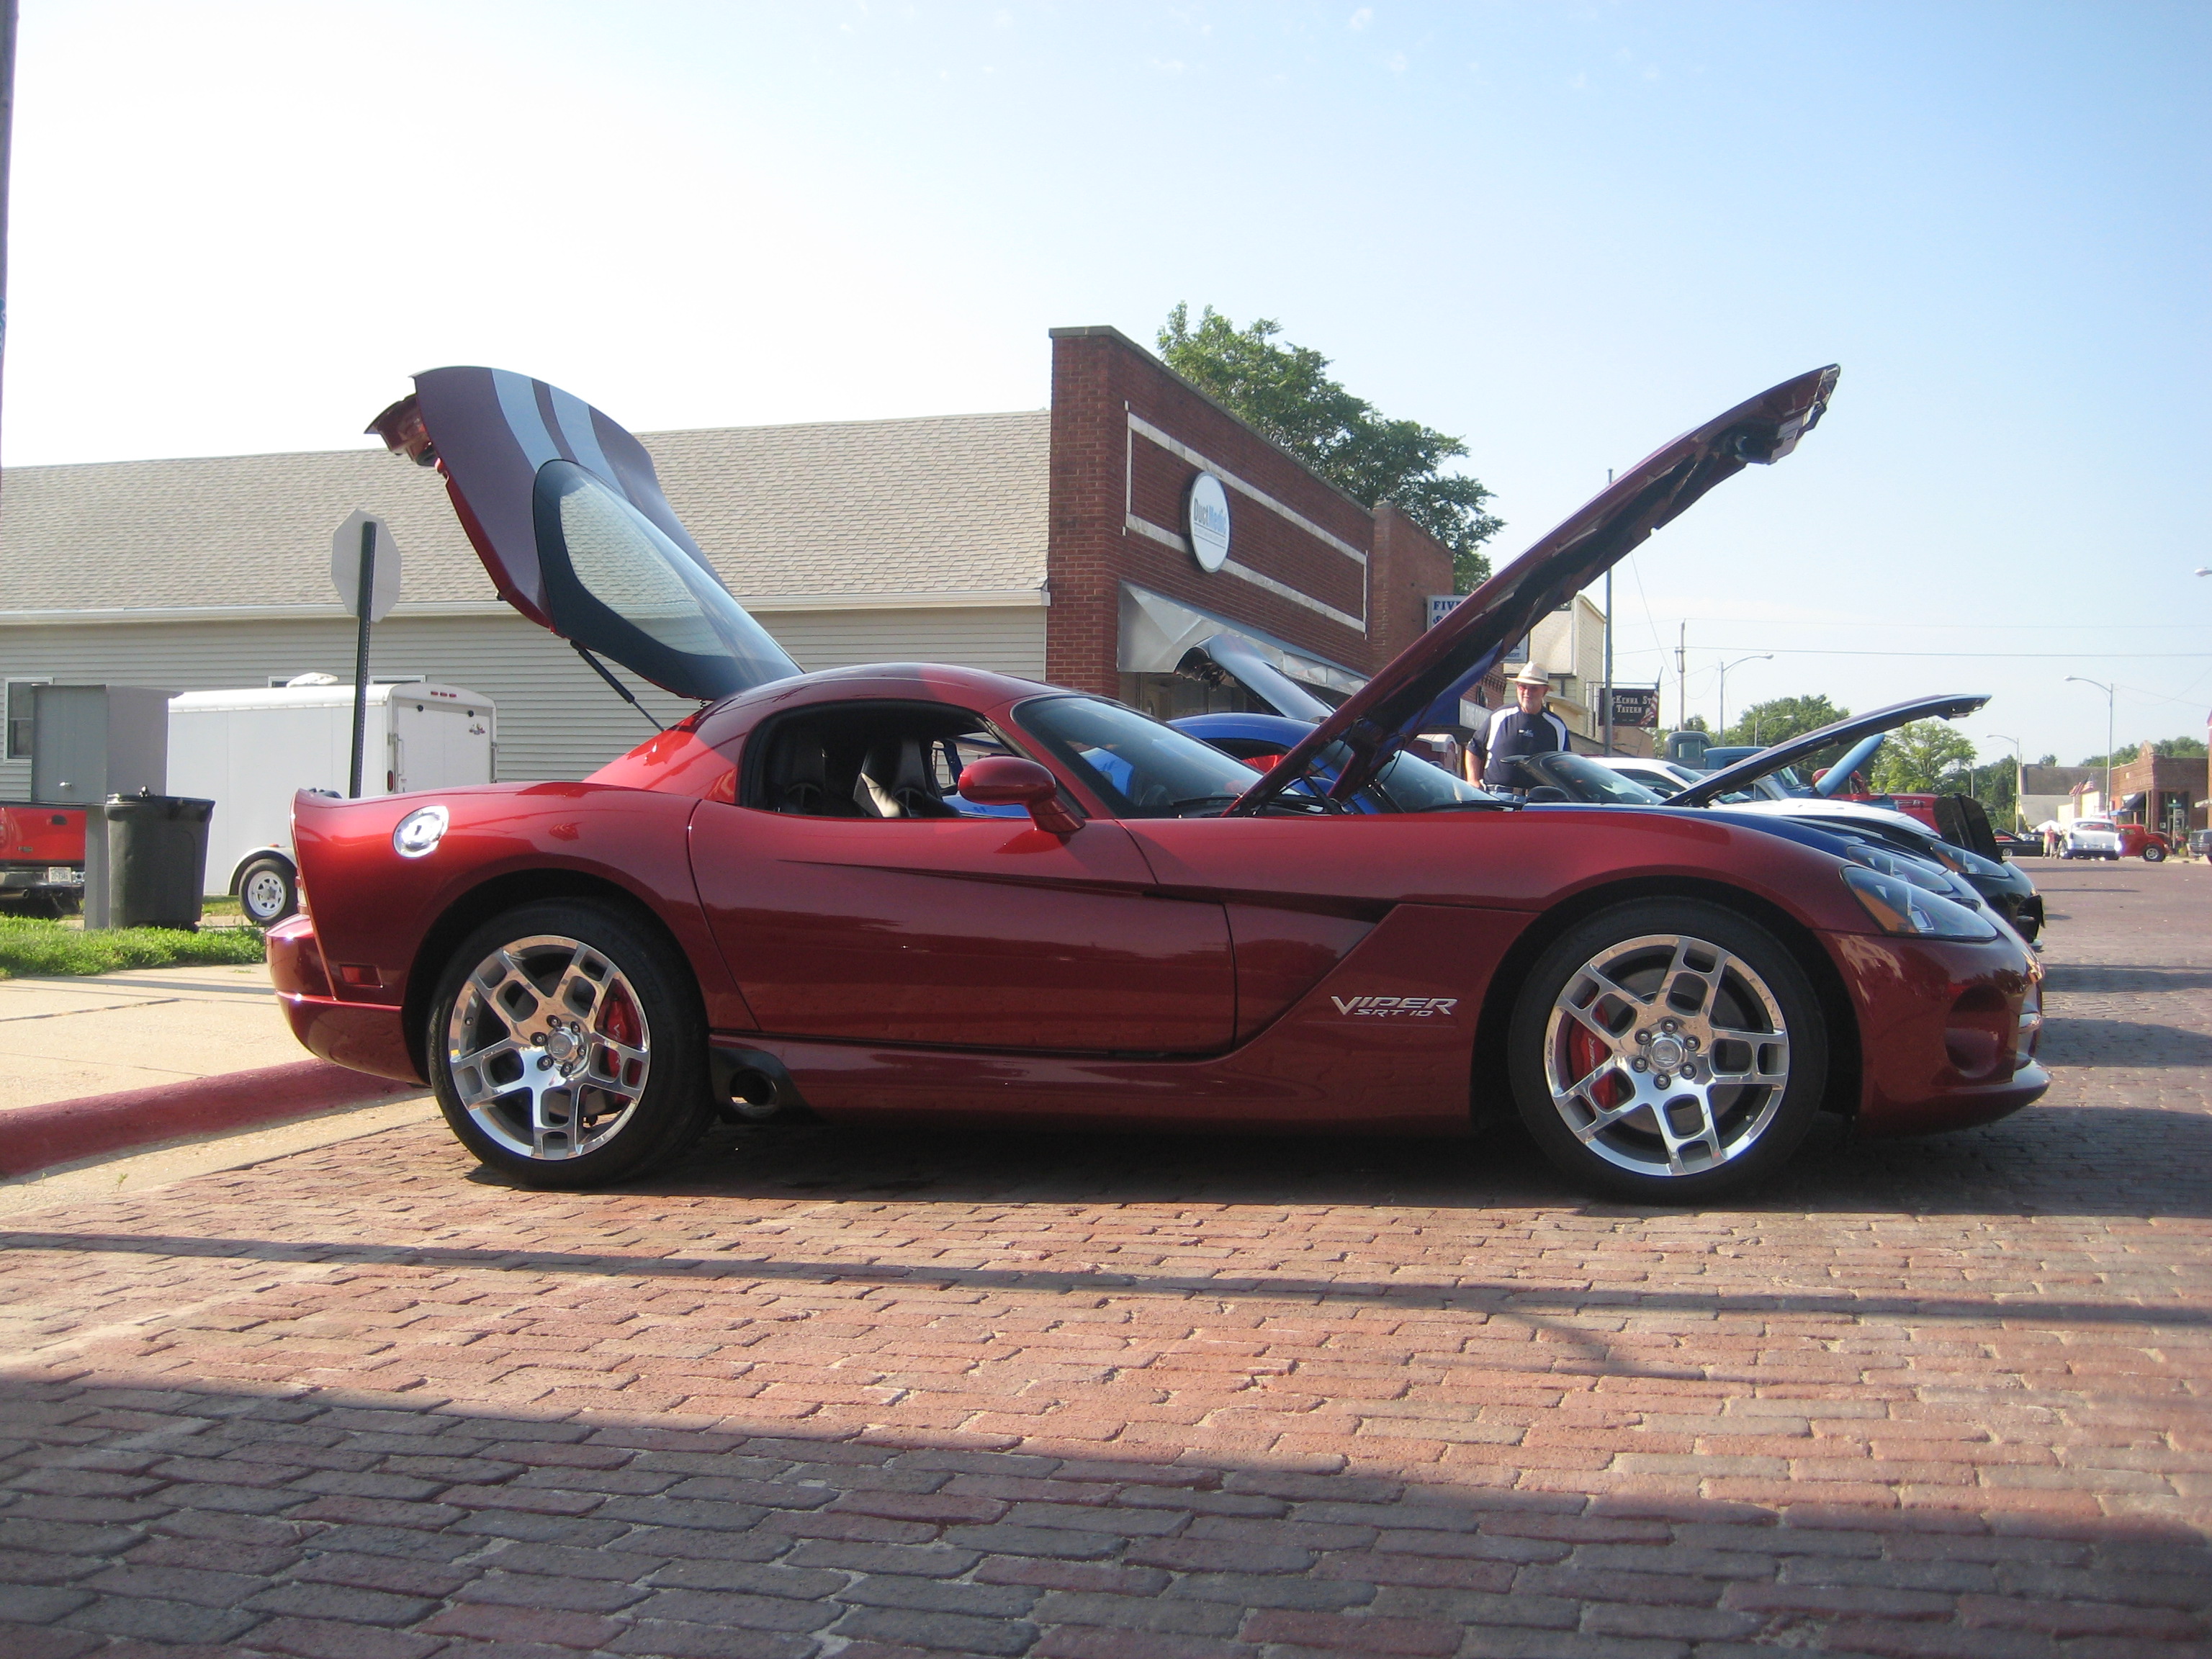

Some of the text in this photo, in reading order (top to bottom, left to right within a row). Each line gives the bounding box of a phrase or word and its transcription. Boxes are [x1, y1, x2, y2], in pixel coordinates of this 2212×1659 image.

[1433, 601, 1462, 611] FIV
[1331, 996, 1457, 1015] VIPER
[1354, 1009, 1404, 1017] SRT
